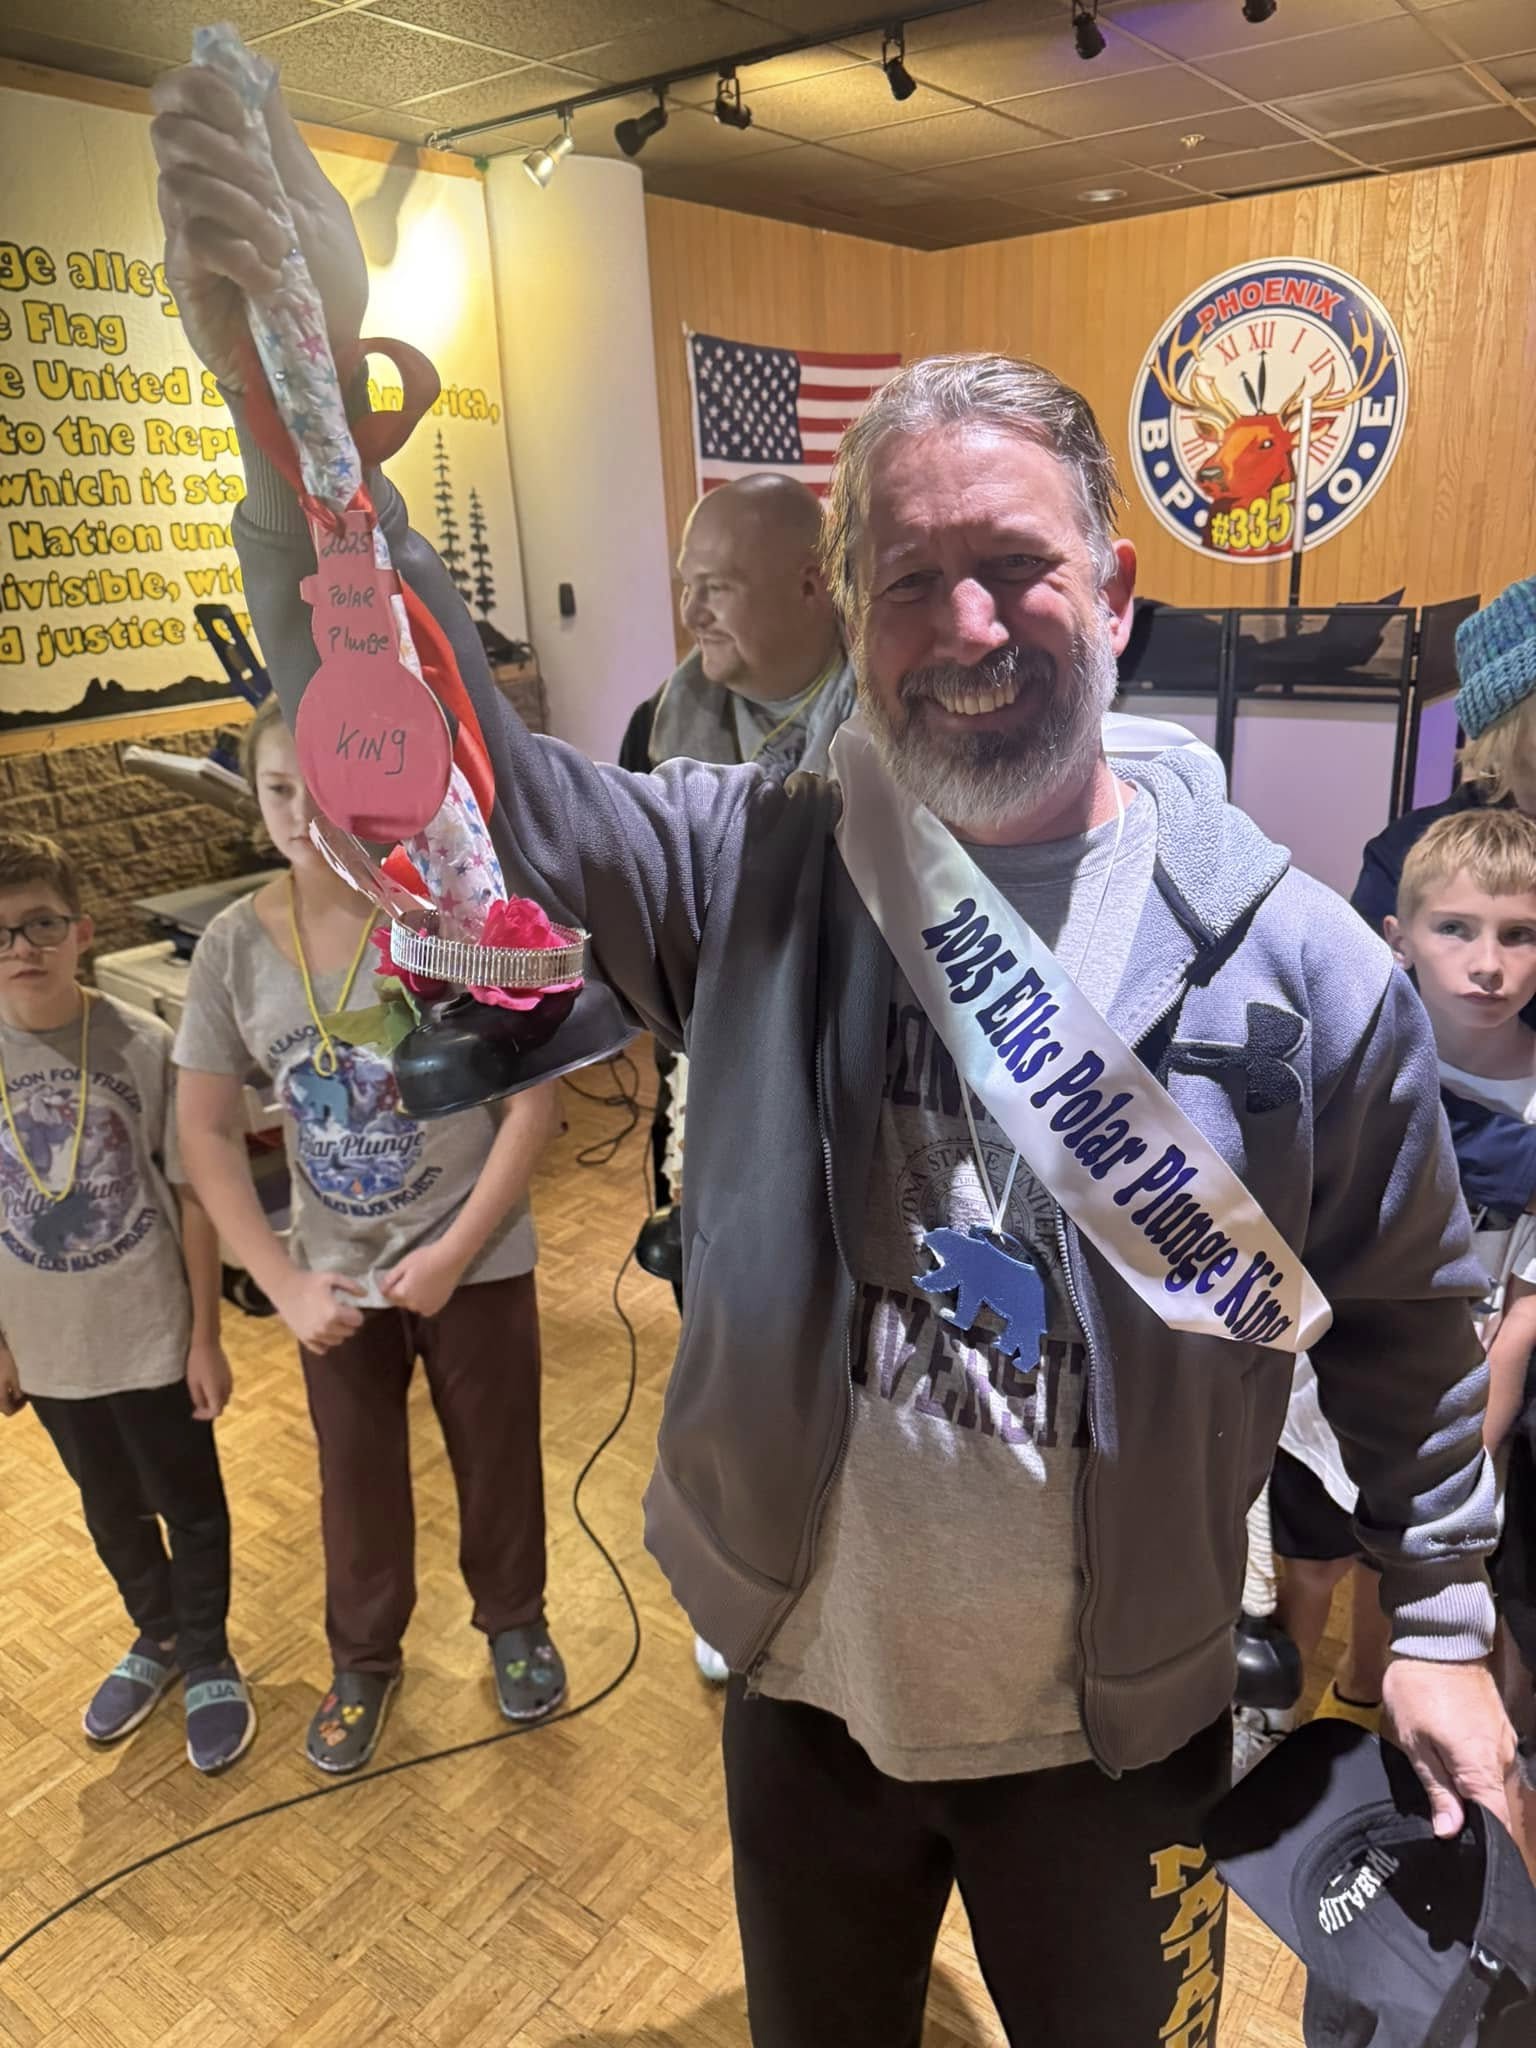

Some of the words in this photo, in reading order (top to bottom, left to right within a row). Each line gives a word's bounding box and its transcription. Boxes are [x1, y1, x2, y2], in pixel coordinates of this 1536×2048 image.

[1197, 277, 1345, 333] PHOENIX
[23, 300, 127, 355] Flag
[1248, 321, 1276, 351] XII
[33, 360, 191, 404] United
[53, 415, 135, 456] the
[0, 468, 131, 507] which
[140, 467, 176, 505] it
[1211, 482, 1294, 550] #335
[8, 519, 162, 560] Nation
[37, 616, 185, 667] justice
[921, 898, 1018, 1004] 2025
[975, 967, 1064, 1083] Elks
[1030, 1050, 1148, 1180] Polar
[1112, 1143, 1240, 1294] Plunge
[1214, 1250, 1293, 1343] King
[208, 1684, 236, 1698] UA
